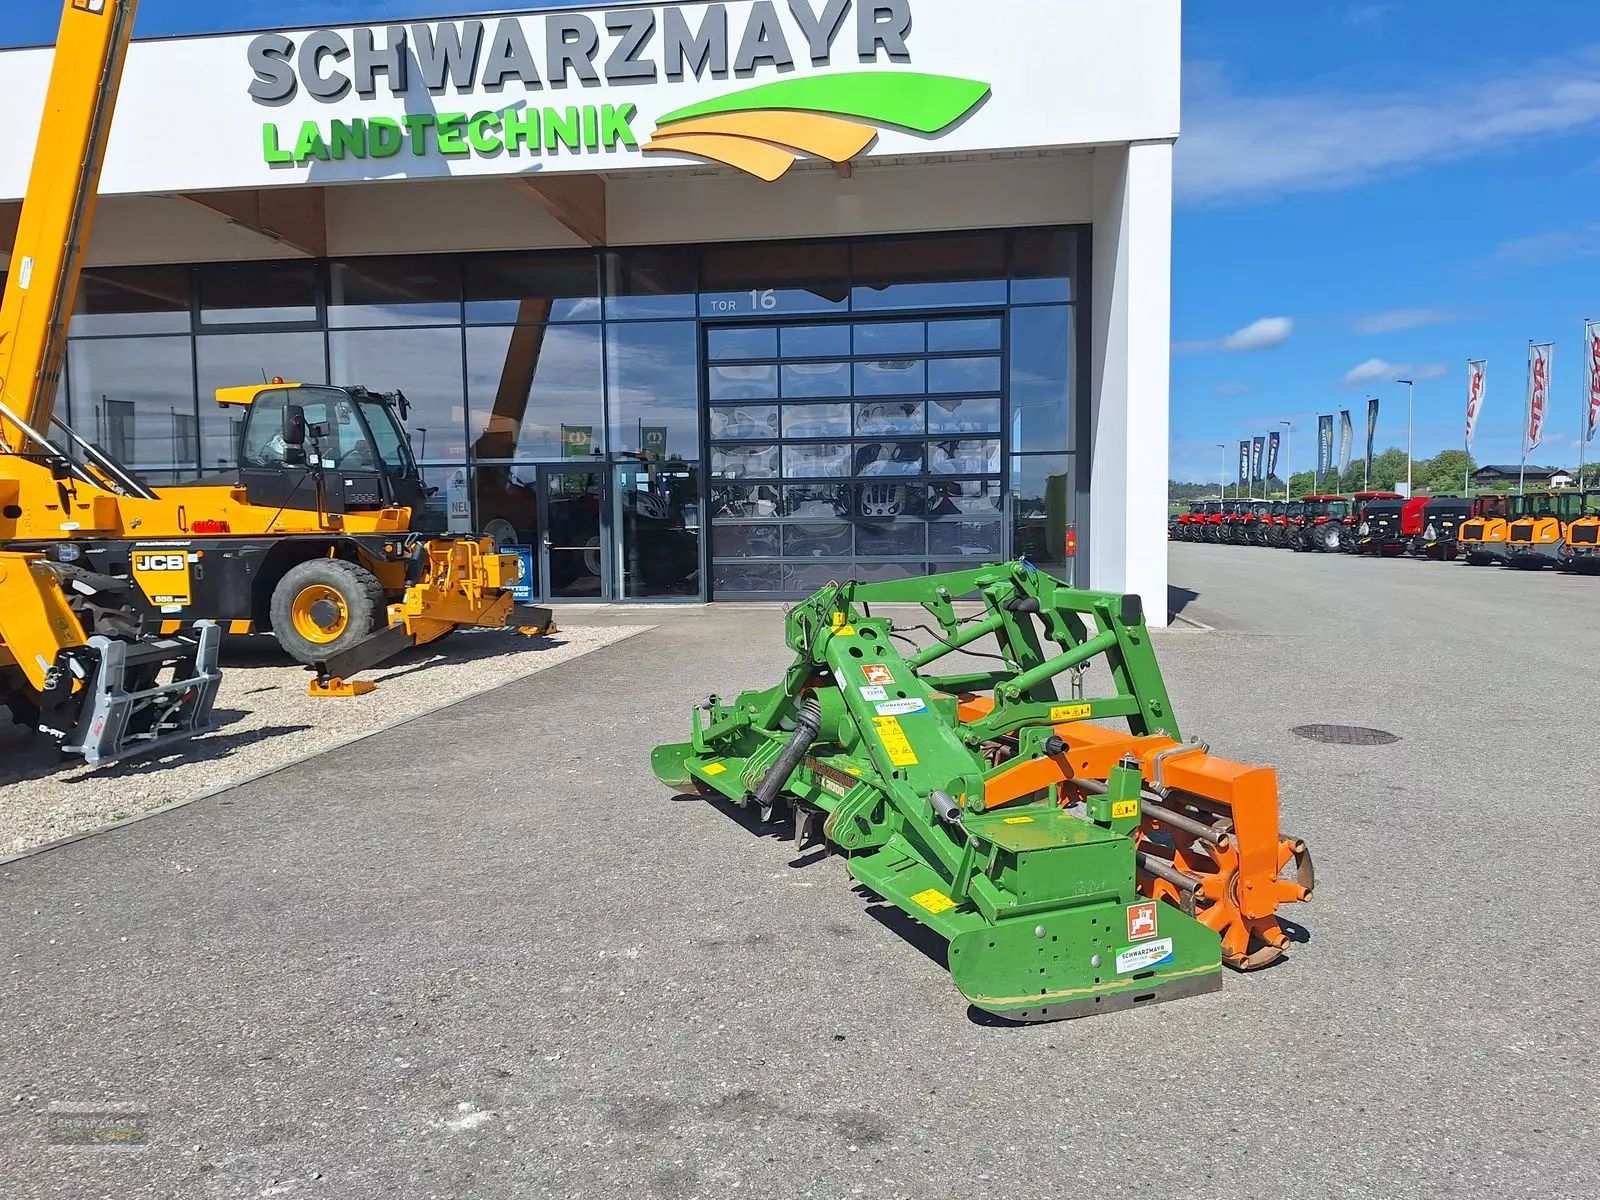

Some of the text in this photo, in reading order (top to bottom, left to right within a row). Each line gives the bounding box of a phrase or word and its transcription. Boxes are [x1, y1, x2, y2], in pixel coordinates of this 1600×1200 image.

[247, 0, 911, 104] SCHWARZMAYR
[263, 103, 639, 165] LANDTECHNIK
[711, 289, 776, 311] TOR 16
[136, 555, 184, 571] JCB
[1121, 945, 1165, 960] SCHWARZMAYR
